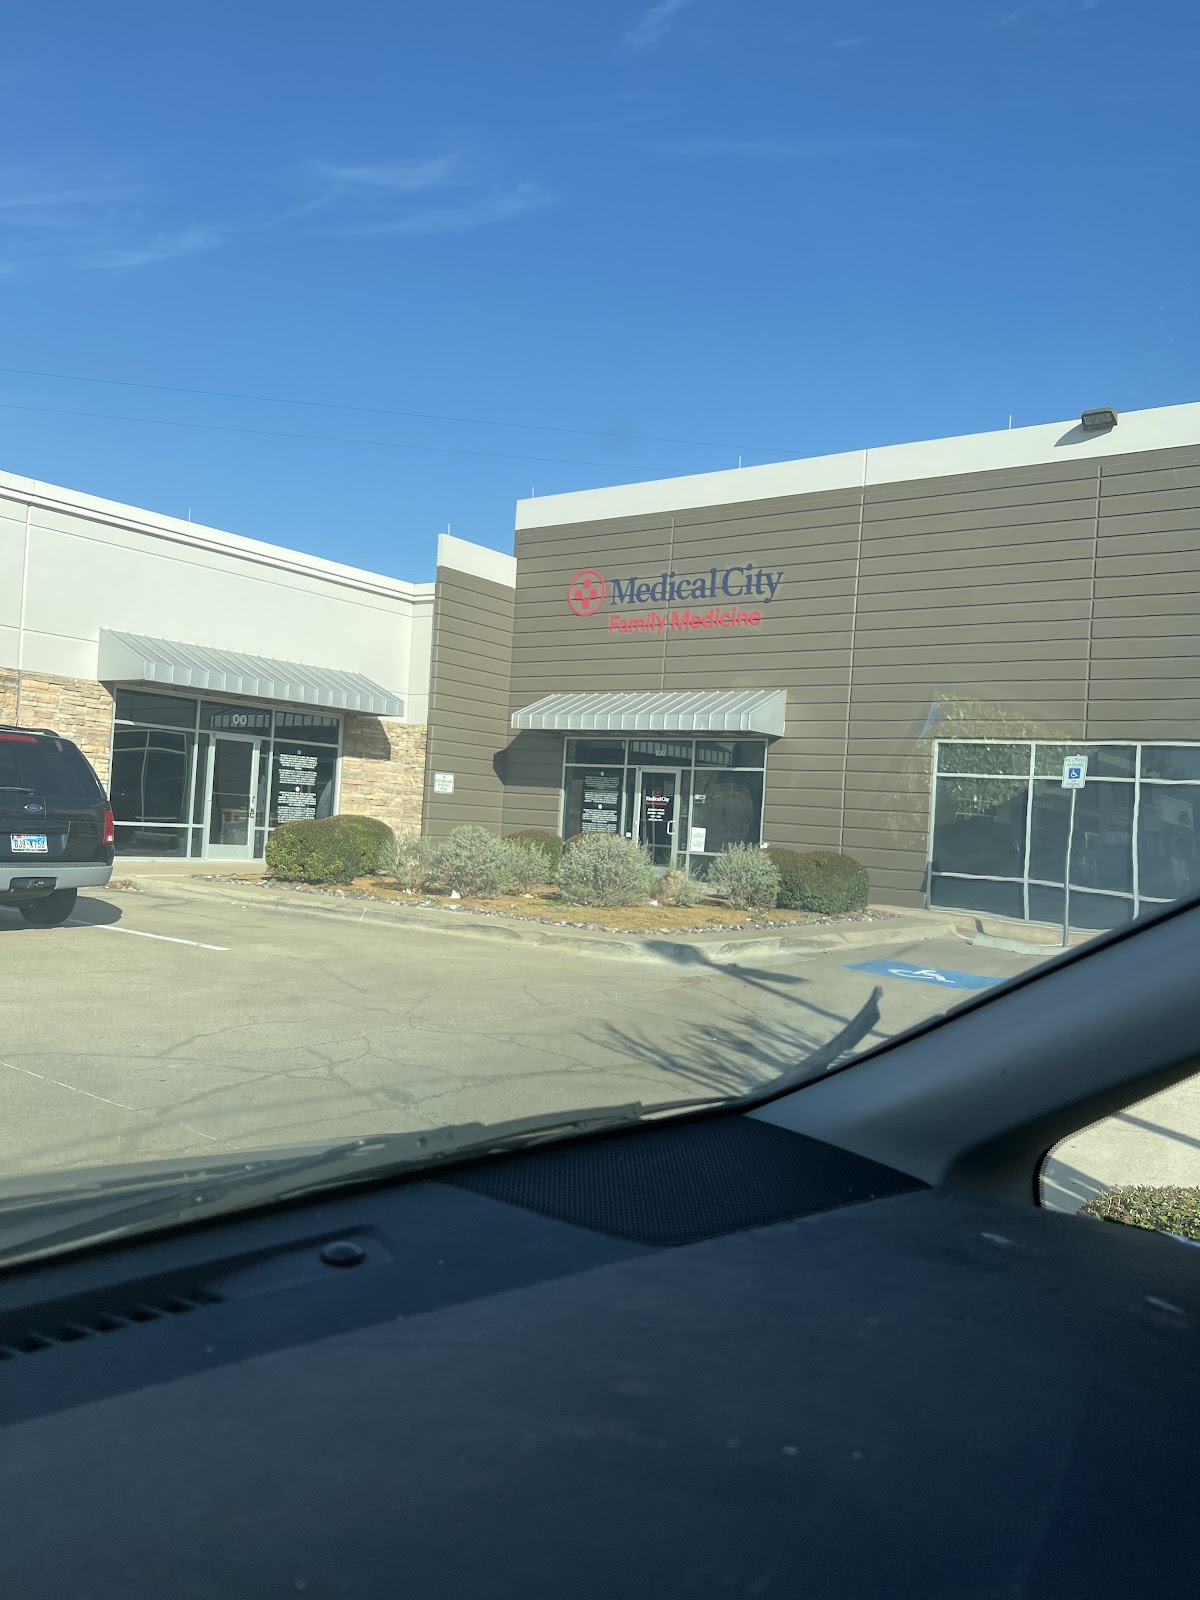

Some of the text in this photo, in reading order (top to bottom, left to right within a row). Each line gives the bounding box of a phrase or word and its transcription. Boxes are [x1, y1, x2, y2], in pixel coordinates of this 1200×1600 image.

[609, 606, 762, 633] Family Medicine
[655, 749, 667, 757] 100
